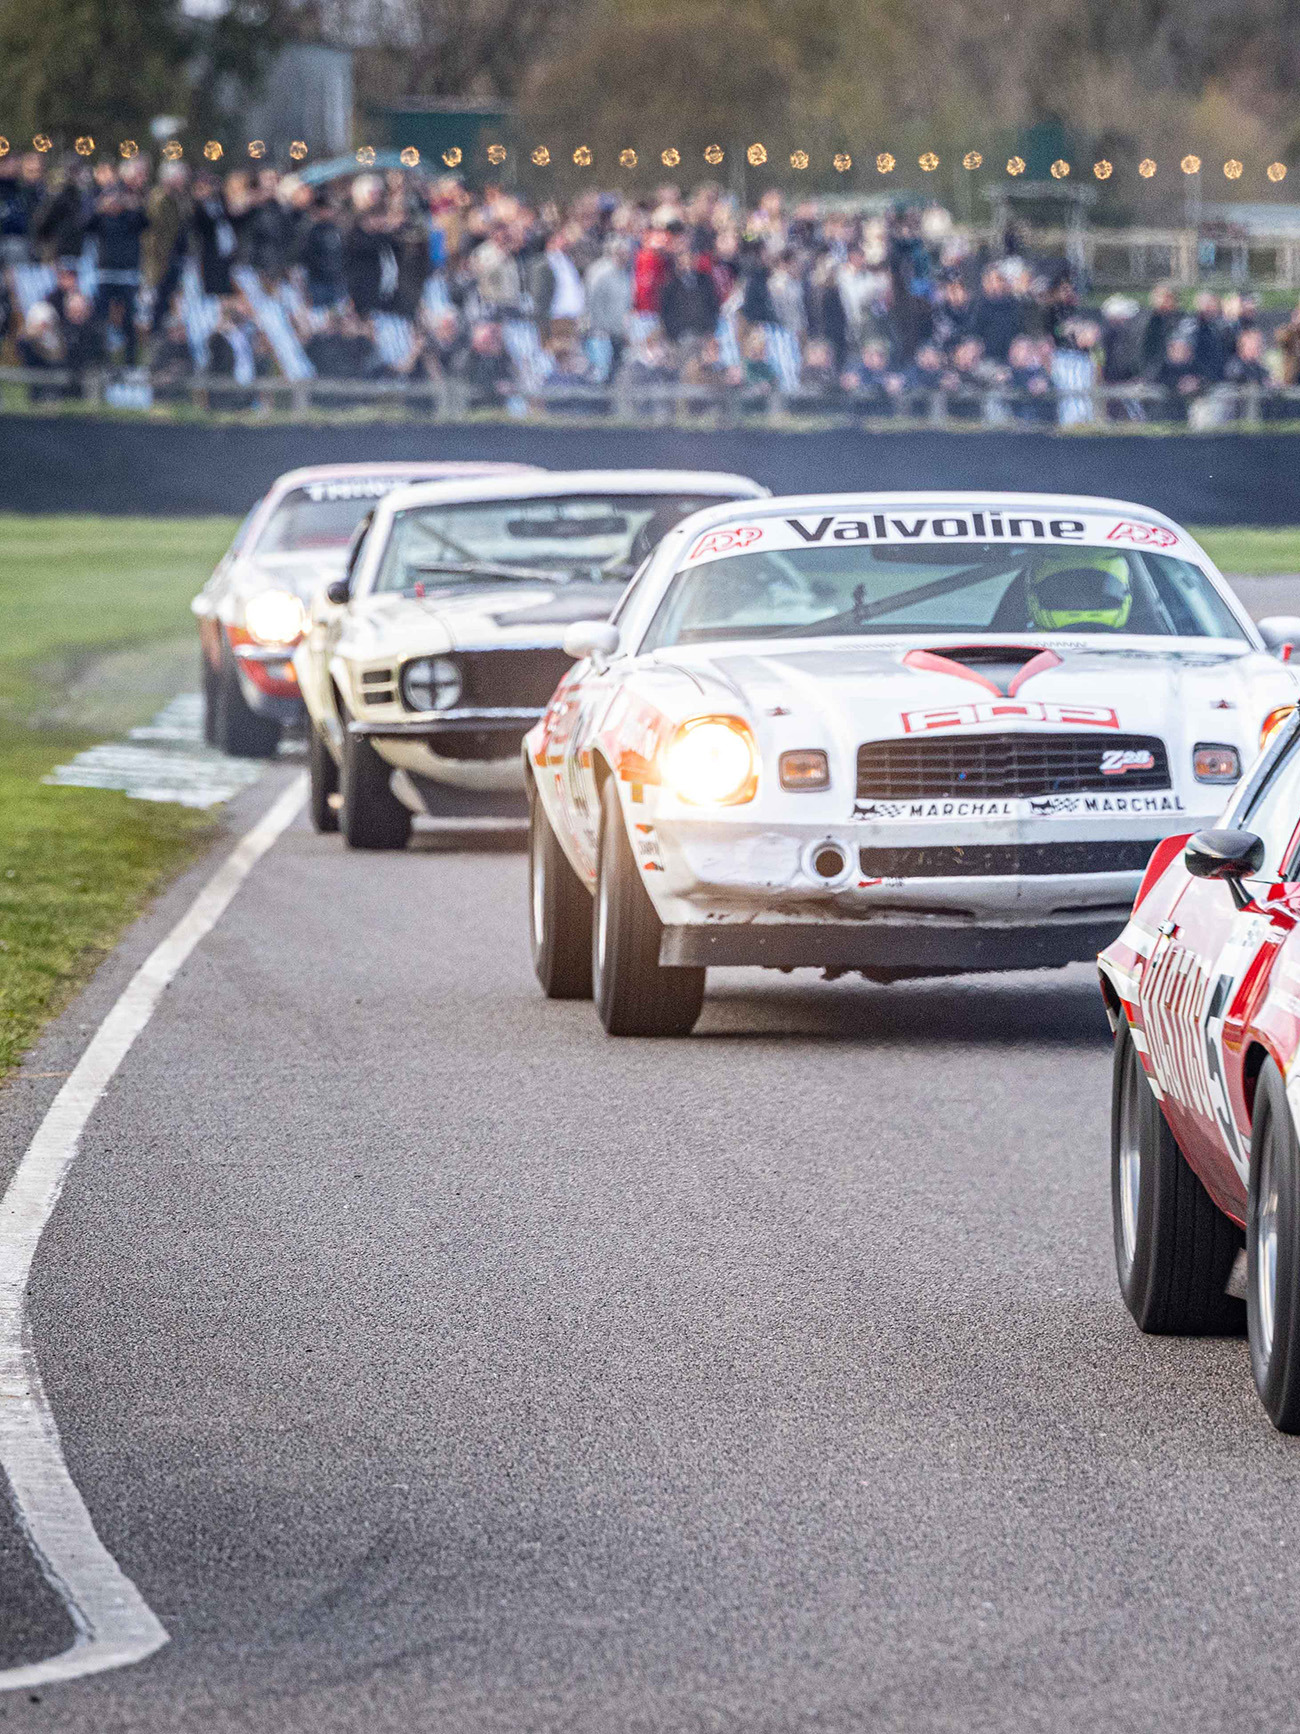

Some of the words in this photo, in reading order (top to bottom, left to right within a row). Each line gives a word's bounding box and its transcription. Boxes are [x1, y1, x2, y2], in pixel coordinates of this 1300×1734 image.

[690, 527, 763, 561] ADP
[786, 511, 1085, 542] Valvoline
[1106, 521, 1180, 548] ADP
[901, 702, 1119, 733] ADP
[909, 802, 1012, 818] MARCHAL
[1085, 796, 1186, 813] MARCHAL
